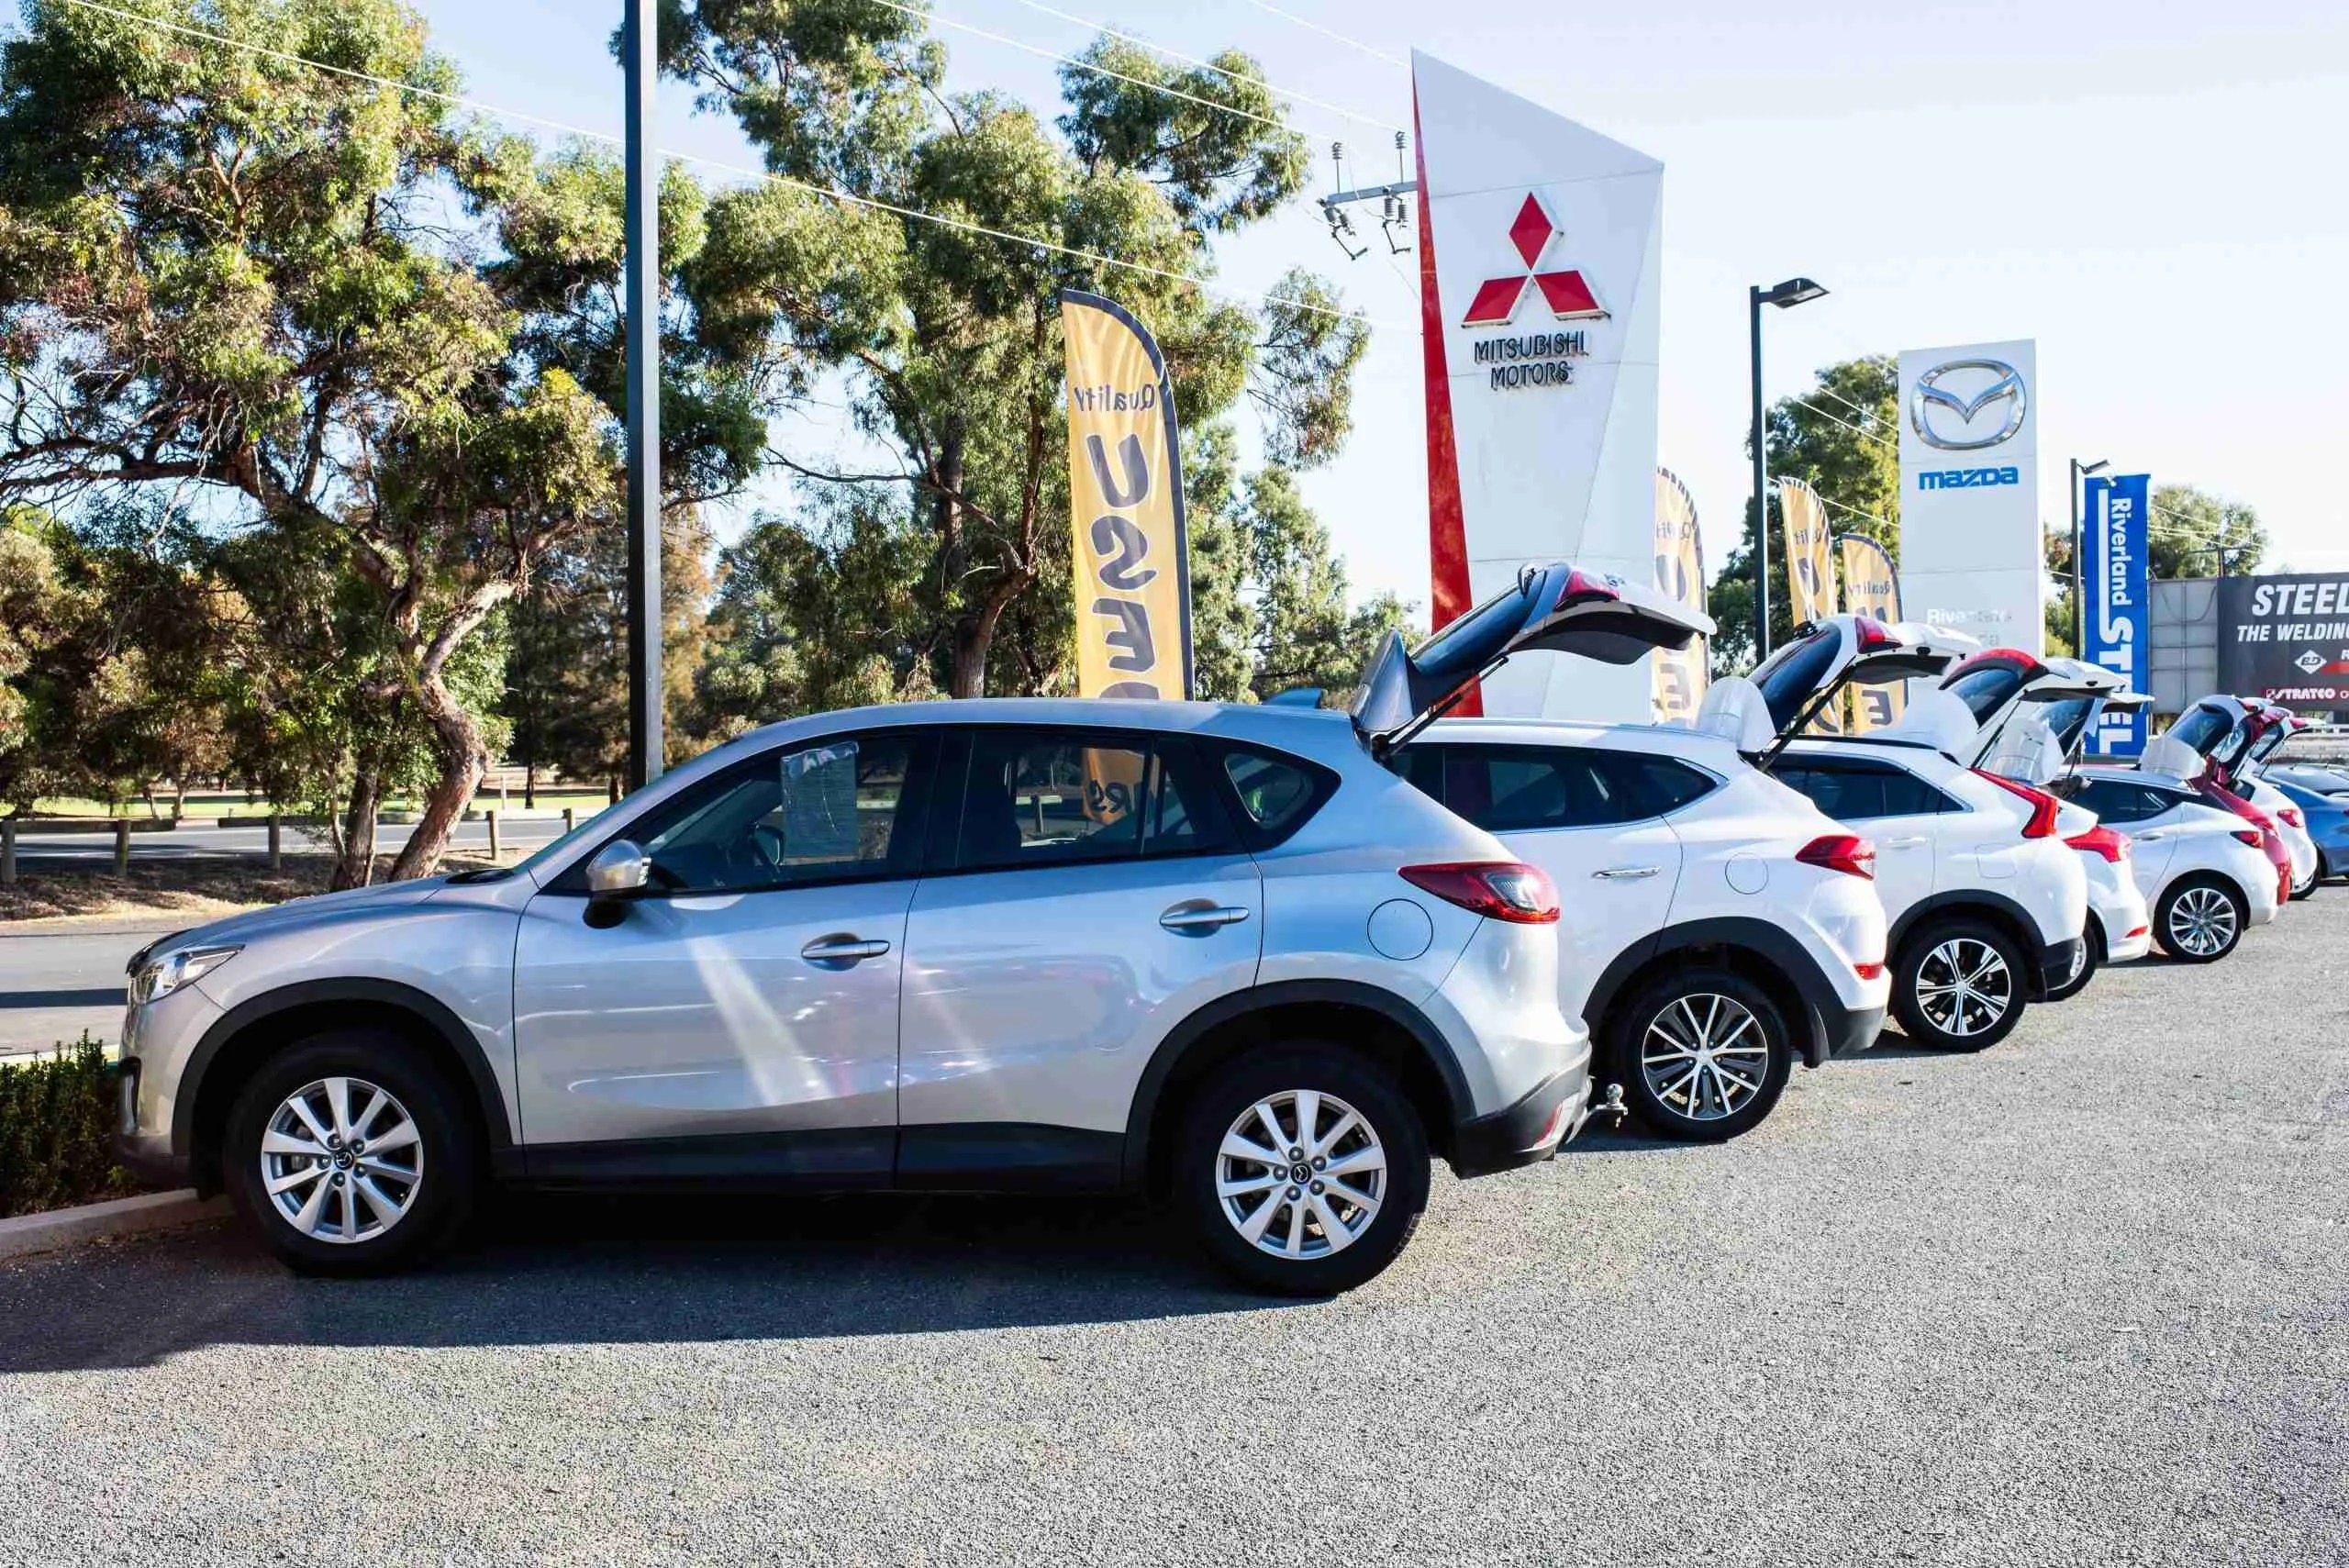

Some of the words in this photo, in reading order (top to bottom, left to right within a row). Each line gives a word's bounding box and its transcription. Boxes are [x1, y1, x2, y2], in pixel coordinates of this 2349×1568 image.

[1475, 330, 1586, 362] MITSUBISHI
[1491, 361, 1571, 388] MOTORS
[1919, 466, 2019, 490] mazda
[2111, 497, 2132, 606] Riverland
[2252, 582, 2349, 617] STEEL
[2237, 624, 2271, 641] THE
[2277, 622, 2349, 640] WELDIN
[2276, 687, 2336, 700] STRATCO
